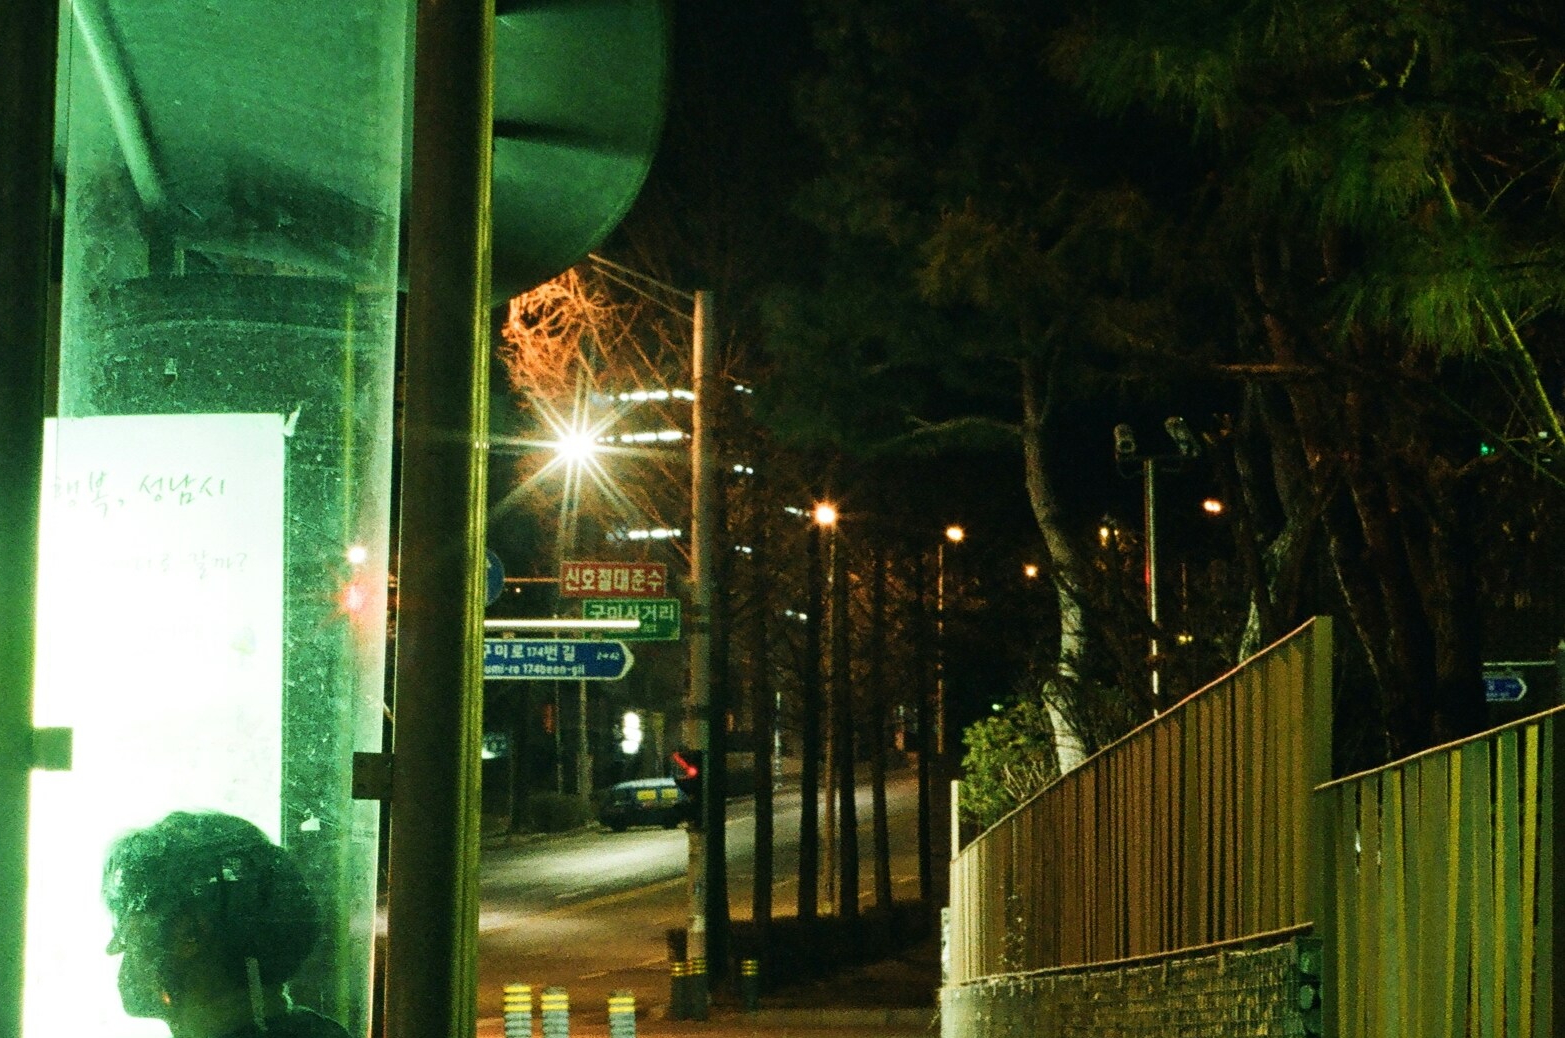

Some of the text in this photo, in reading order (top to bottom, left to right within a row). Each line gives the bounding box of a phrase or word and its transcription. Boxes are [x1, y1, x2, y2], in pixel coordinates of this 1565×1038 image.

[138, 473, 226, 506] 성남시
[564, 567, 664, 592] 신호절대준수
[588, 603, 675, 621] 구미사거리
[484, 663, 521, 675] umi-ro
